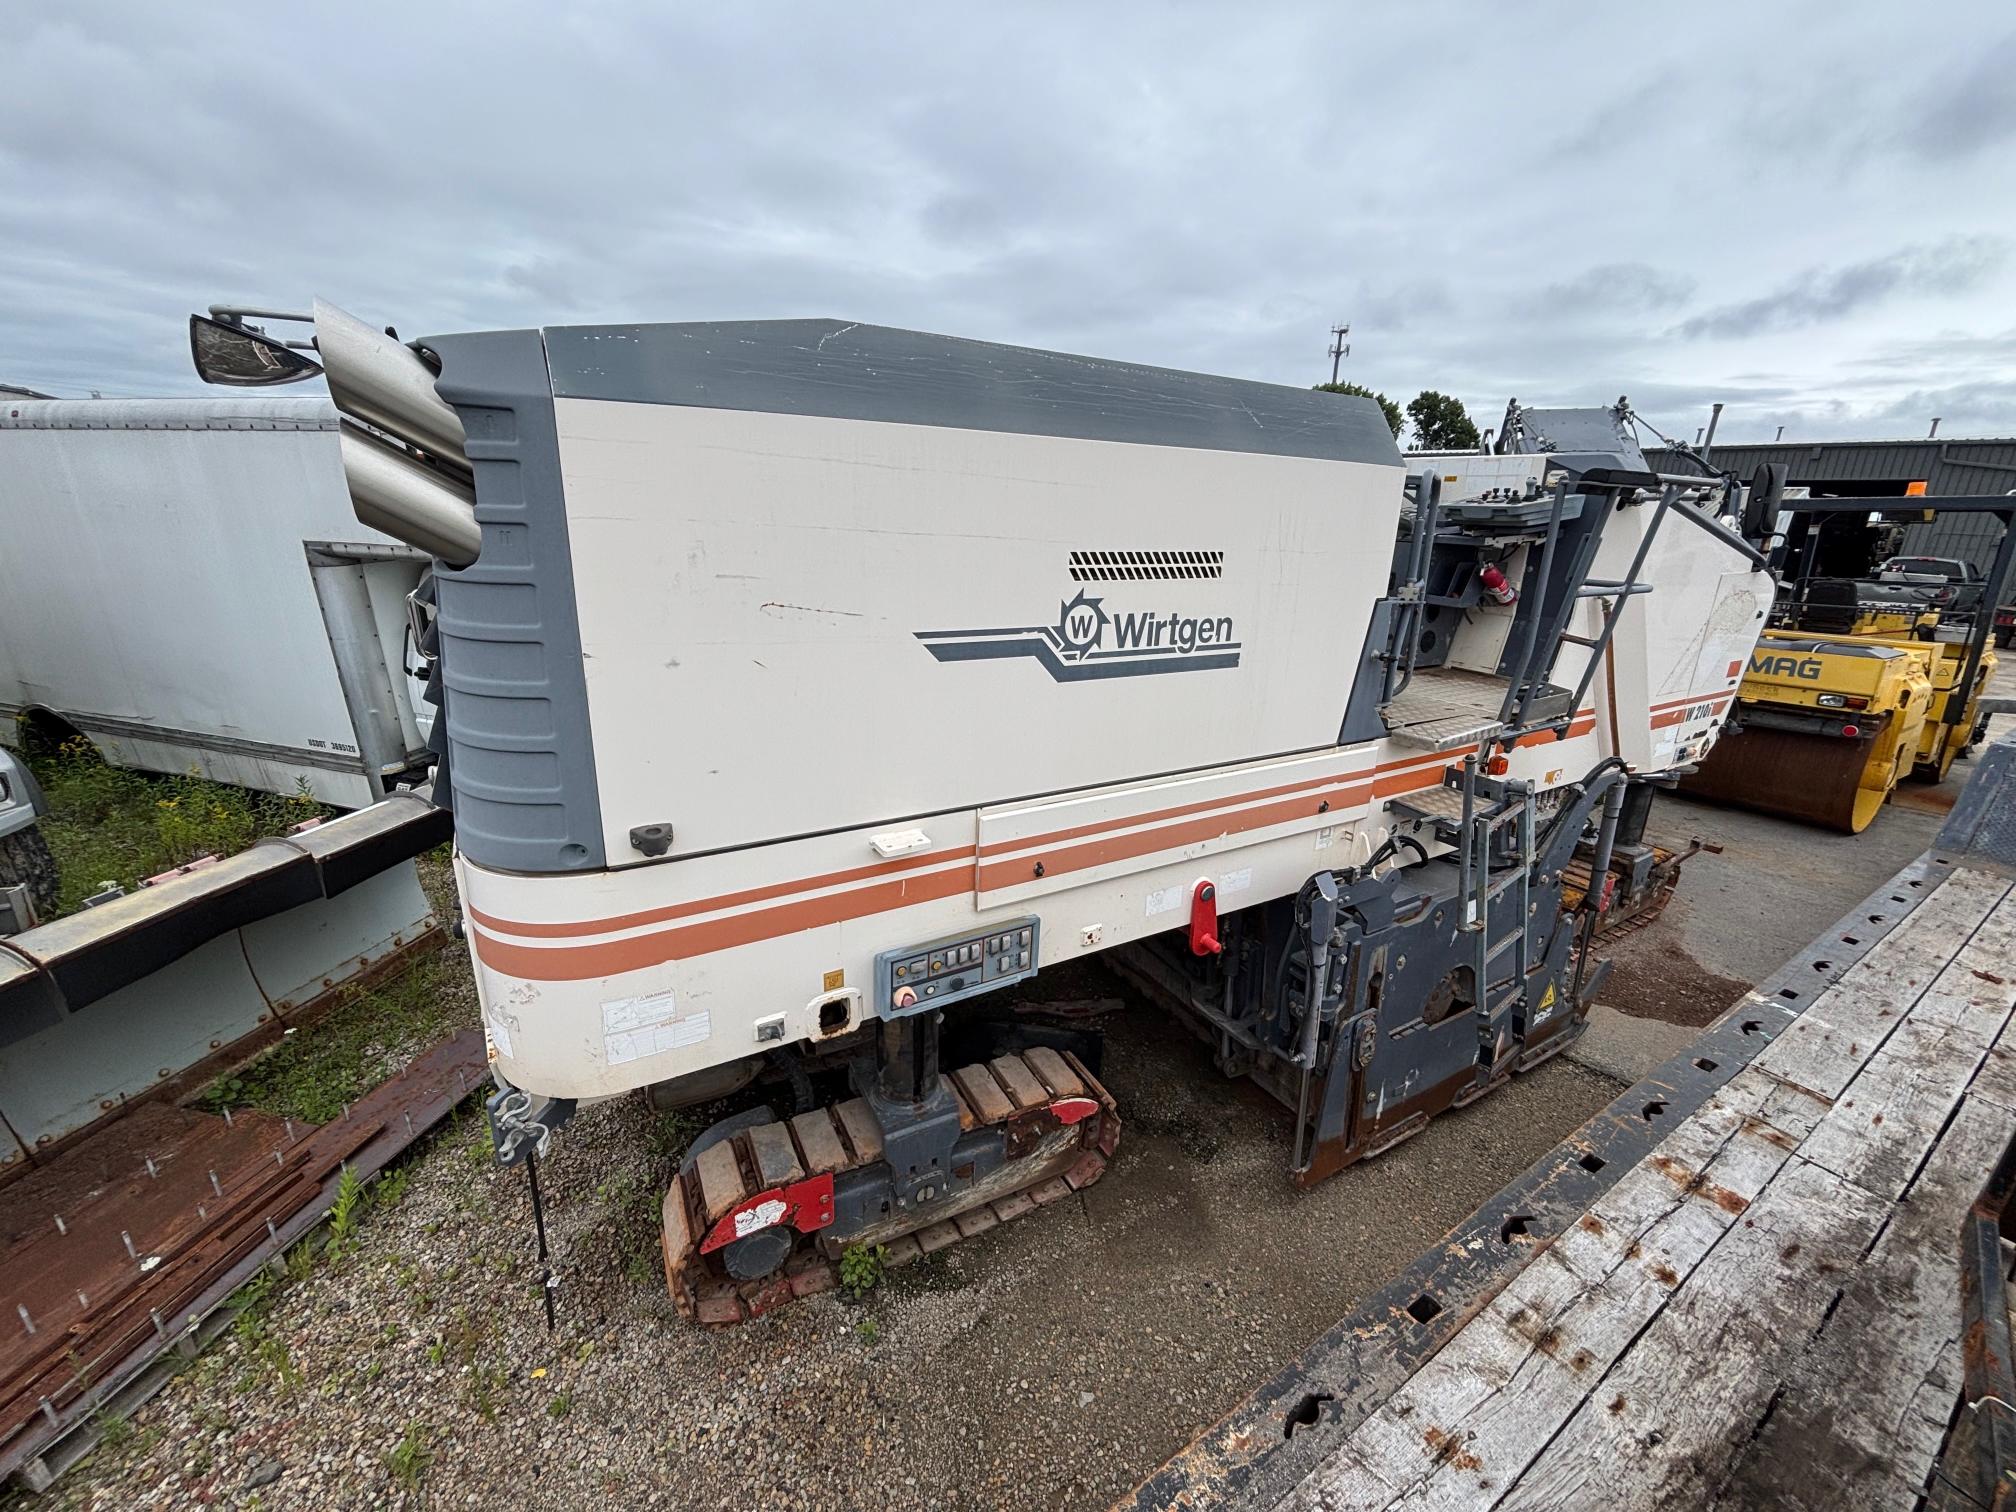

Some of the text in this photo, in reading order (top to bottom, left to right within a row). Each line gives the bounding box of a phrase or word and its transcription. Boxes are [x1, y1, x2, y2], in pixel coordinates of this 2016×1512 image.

[1113, 612, 1233, 654] Wirtgen
[1685, 702, 1713, 722] W 210i
